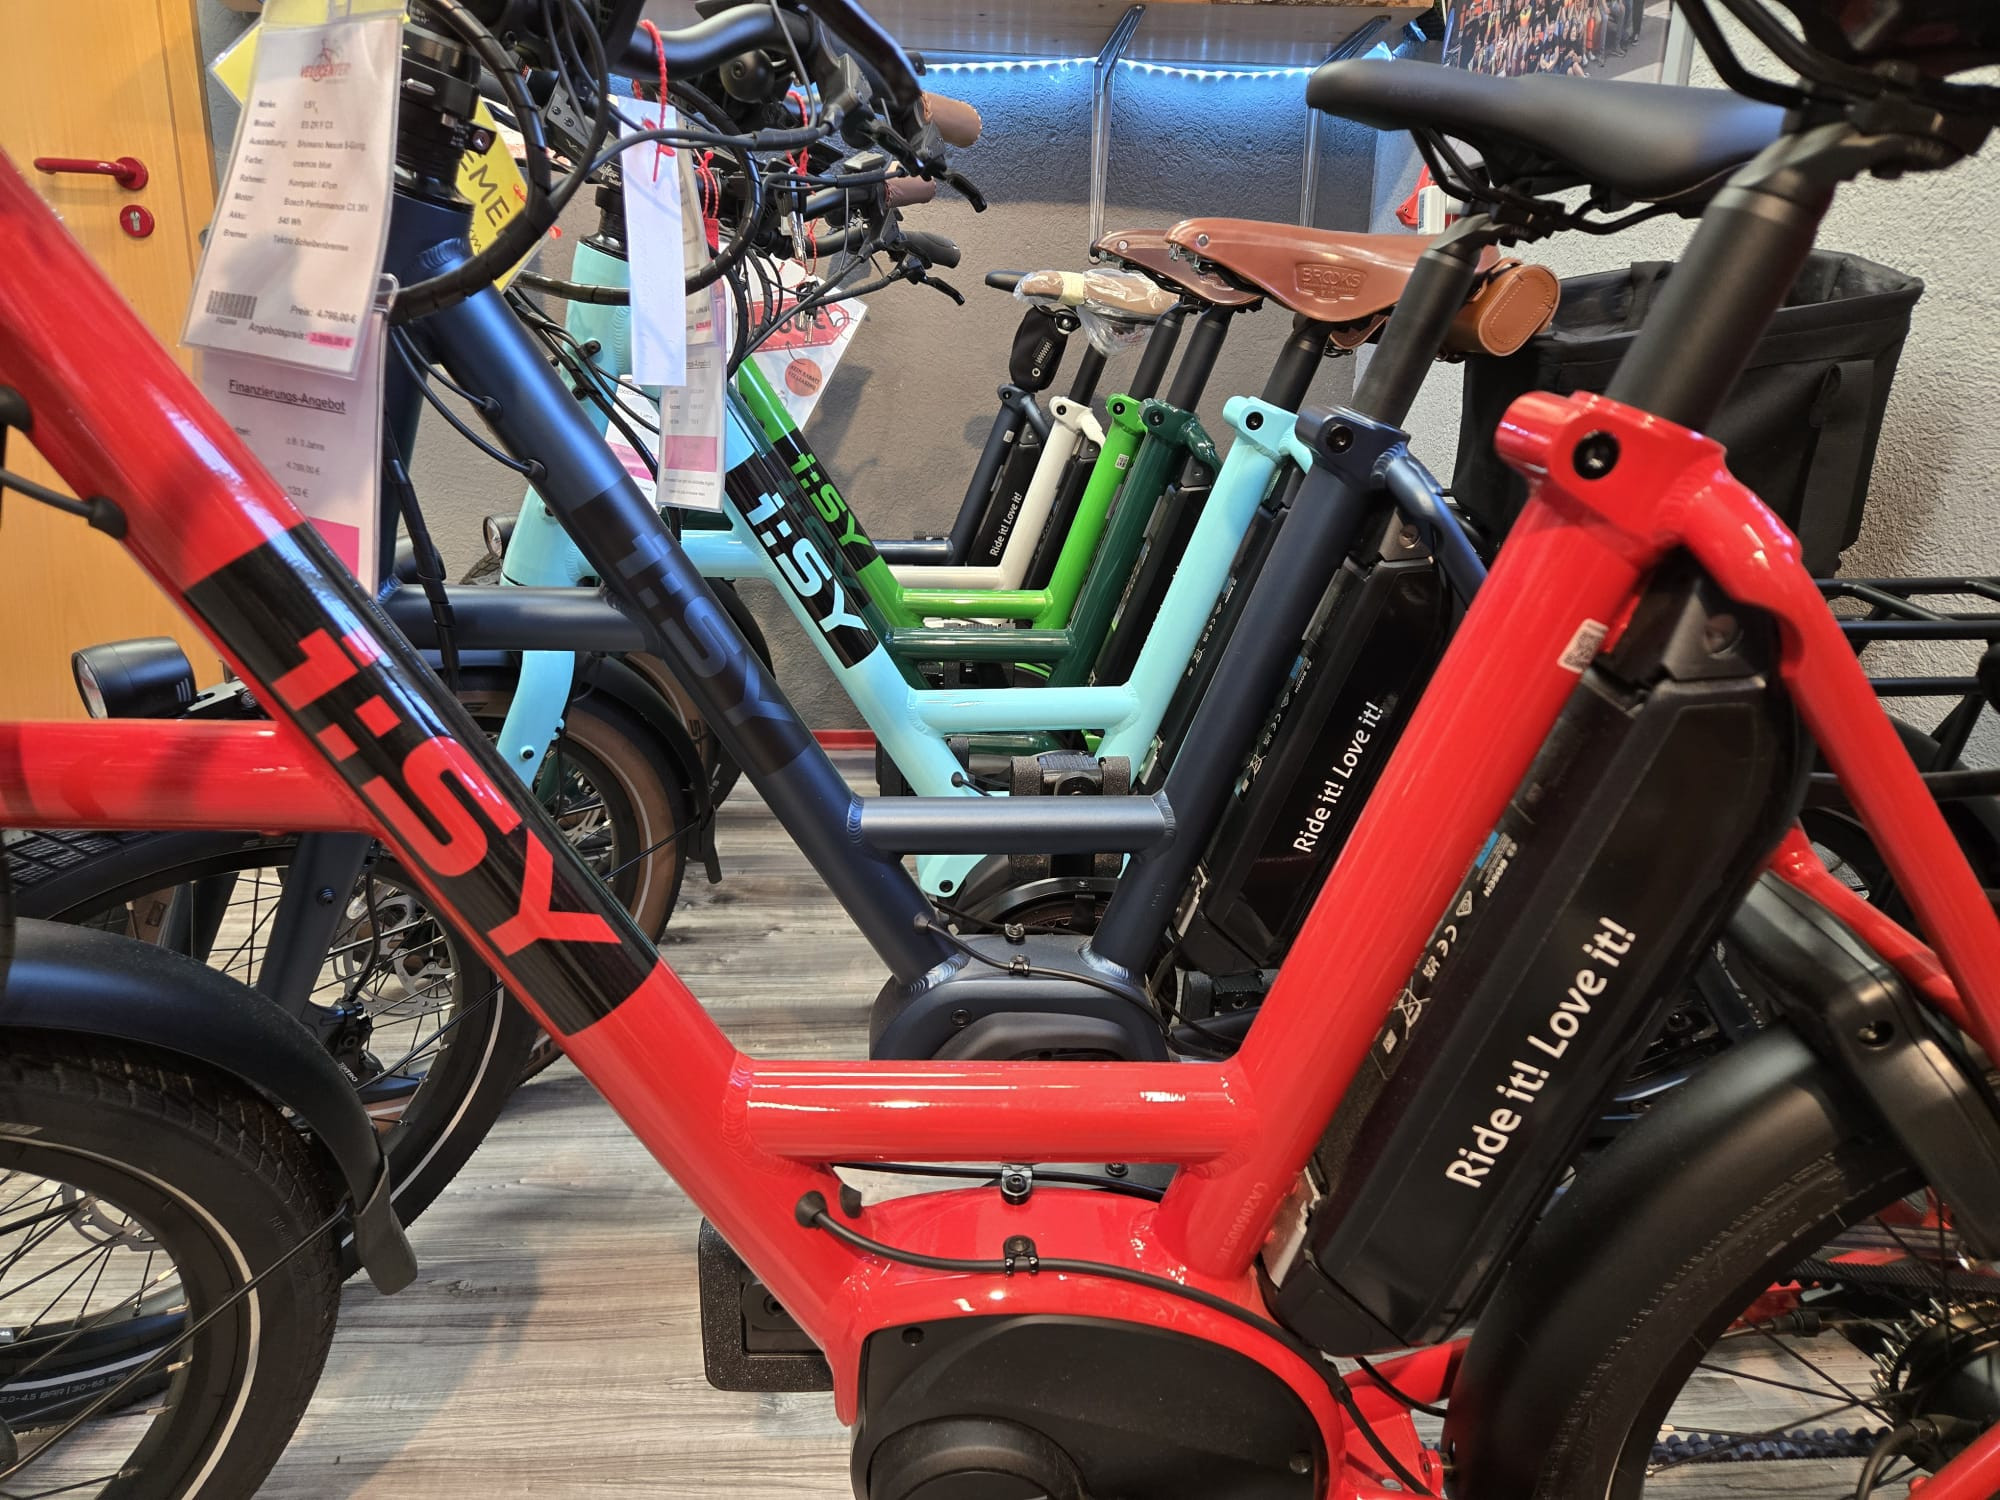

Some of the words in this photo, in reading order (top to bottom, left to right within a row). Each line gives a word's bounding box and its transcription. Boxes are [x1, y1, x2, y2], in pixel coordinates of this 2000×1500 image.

[1302, 267, 1361, 288] BROOKS
[228, 379, 346, 413] Finanzierungs-Angebot
[1012, 491, 1022, 504] it!
[1003, 503, 1018, 525] Love
[998, 524, 1009, 536] it!
[989, 536, 1005, 556] Ride
[1293, 807, 1332, 854] Ride
[1320, 780, 1344, 804] it!
[1332, 729, 1371, 780] Love
[1358, 701, 1383, 728] it!
[1445, 1108, 1522, 1188] Ride
[1497, 1060, 1550, 1103] it!
[1527, 969, 1608, 1058] Love
[1583, 917, 1637, 967] it!
